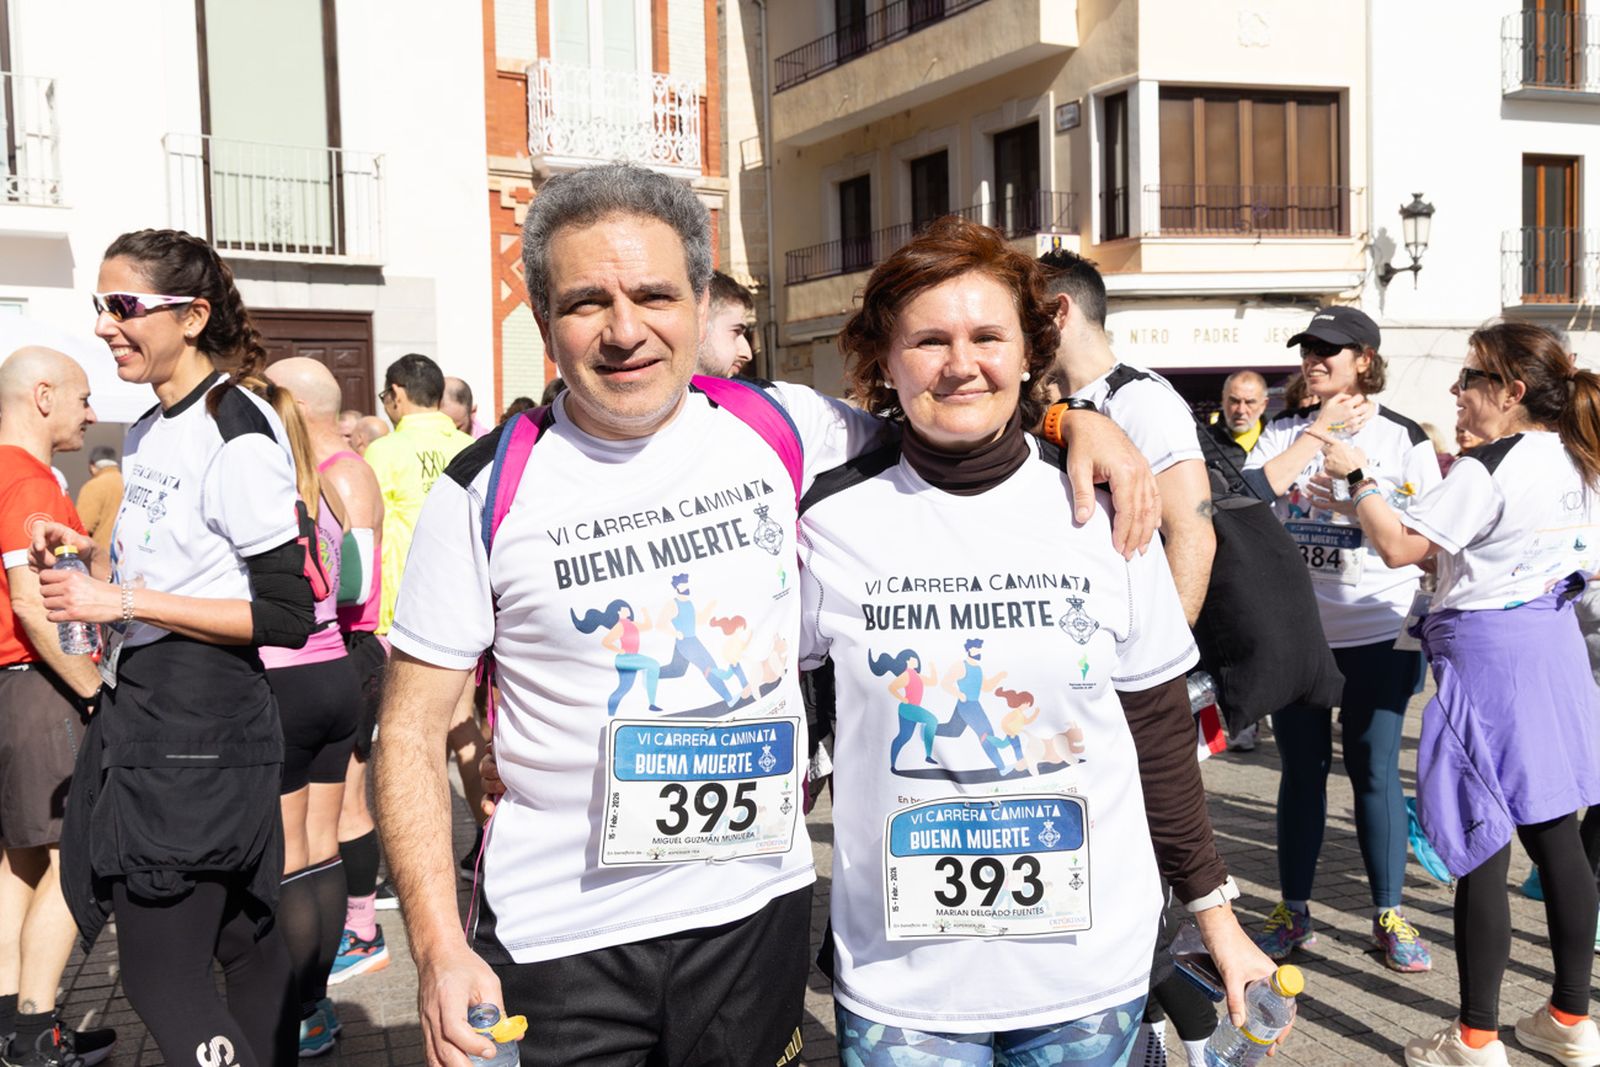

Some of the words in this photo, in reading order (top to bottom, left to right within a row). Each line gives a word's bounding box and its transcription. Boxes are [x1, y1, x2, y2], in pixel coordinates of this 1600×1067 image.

[1194, 327, 1239, 343] PADRE
[547, 527, 569, 546] VI
[575, 506, 675, 539] CARRERA
[679, 478, 774, 517] CAMINATA
[1311, 534, 1340, 545] MUERTE
[553, 545, 645, 590] BUENA
[647, 517, 750, 569] MUERTE
[1299, 545, 1341, 568] 384
[865, 579, 881, 596] VI
[887, 575, 983, 594] CARRERA
[989, 573, 1091, 594] CAMINATA
[862, 603, 941, 631] BUENA
[950, 600, 1055, 630] MUERTE
[637, 733, 651, 746] VI
[654, 732, 717, 747] CARRERA
[720, 728, 777, 747] CAMINATA
[635, 753, 688, 775] BUENA
[693, 752, 753, 775] MUERTE
[655, 781, 757, 836] 395
[898, 795, 909, 804] En
[911, 813, 923, 825] VI
[926, 808, 988, 823] CARRERA
[991, 804, 1061, 821] CAMINATA
[652, 837, 682, 845] MIGUEL
[685, 834, 719, 844] GUZMÁN
[910, 829, 962, 850] BUENA
[966, 826, 1031, 849] MUERTE
[934, 855, 1045, 908] 393
[970, 909, 1010, 917] DELGADO
[1012, 907, 1045, 916] FUENTES
